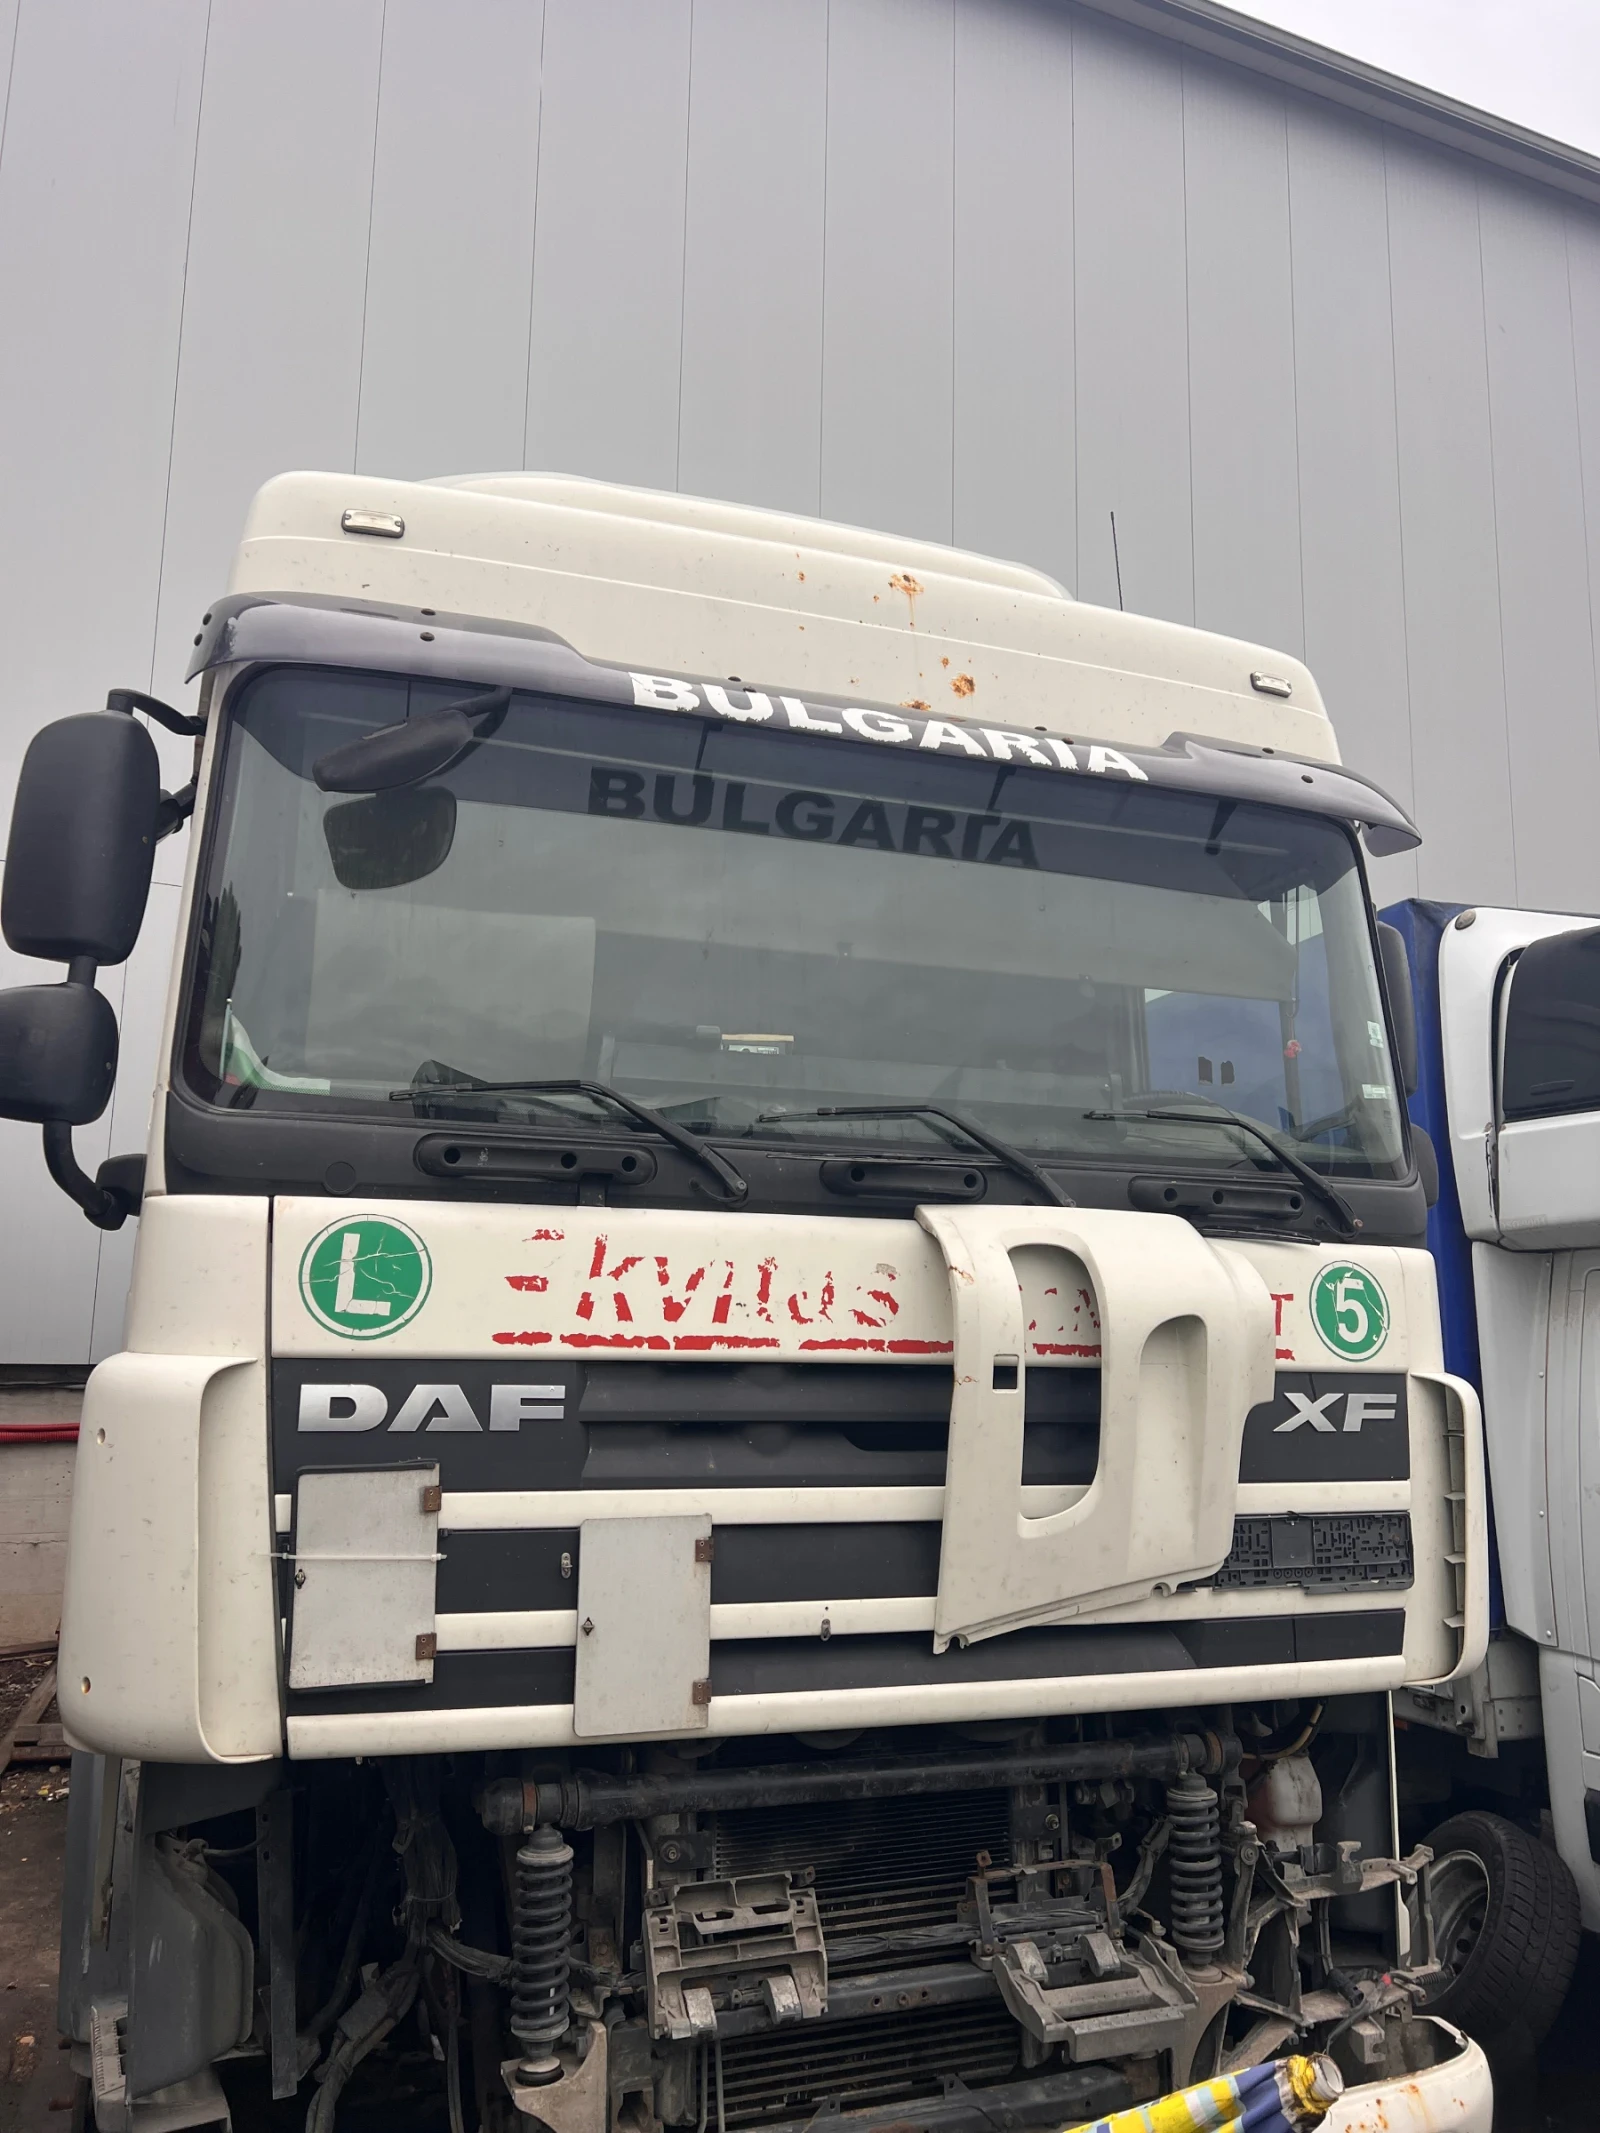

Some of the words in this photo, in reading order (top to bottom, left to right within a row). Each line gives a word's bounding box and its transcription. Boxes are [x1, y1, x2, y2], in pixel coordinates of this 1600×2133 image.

[627, 671, 1149, 781] BULGARIA
[587, 766, 1040, 869] BULGARIA
[335, 1233, 391, 1316] L
[1336, 1278, 1369, 1343] 5
[297, 1384, 566, 1432] DAF
[1273, 1393, 1397, 1432] XF
